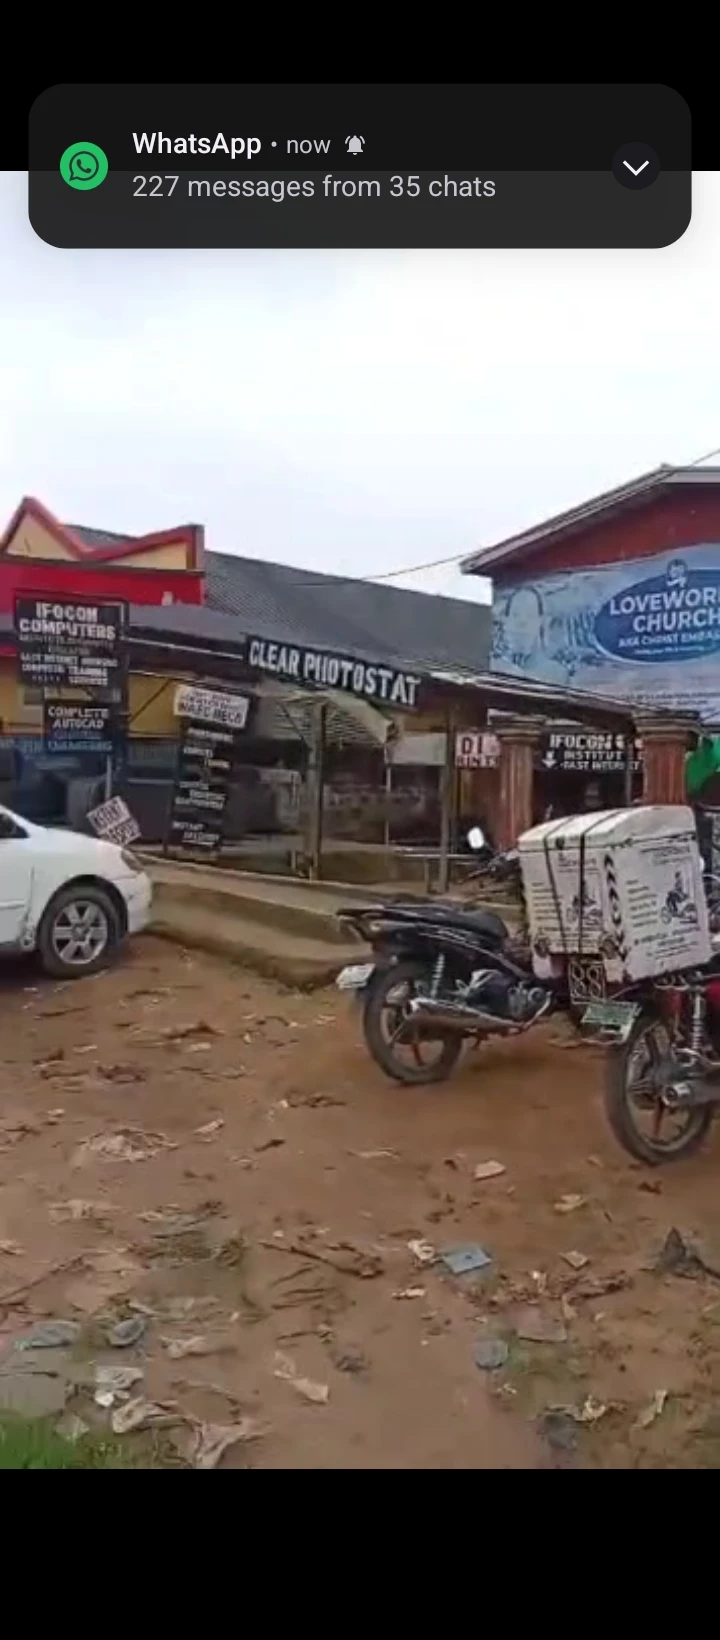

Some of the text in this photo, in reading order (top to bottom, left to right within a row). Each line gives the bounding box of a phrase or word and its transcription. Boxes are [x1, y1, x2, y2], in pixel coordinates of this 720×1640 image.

[632, 606, 720, 633] CHURCH
[20, 618, 117, 640] COMPUTERS
[249, 641, 421, 706] CLEAR PHOTOSTAT
[48, 706, 109, 719] COMPLETE
[52, 718, 104, 730] AUTOCAD
[564, 750, 631, 761] INSTITUT
